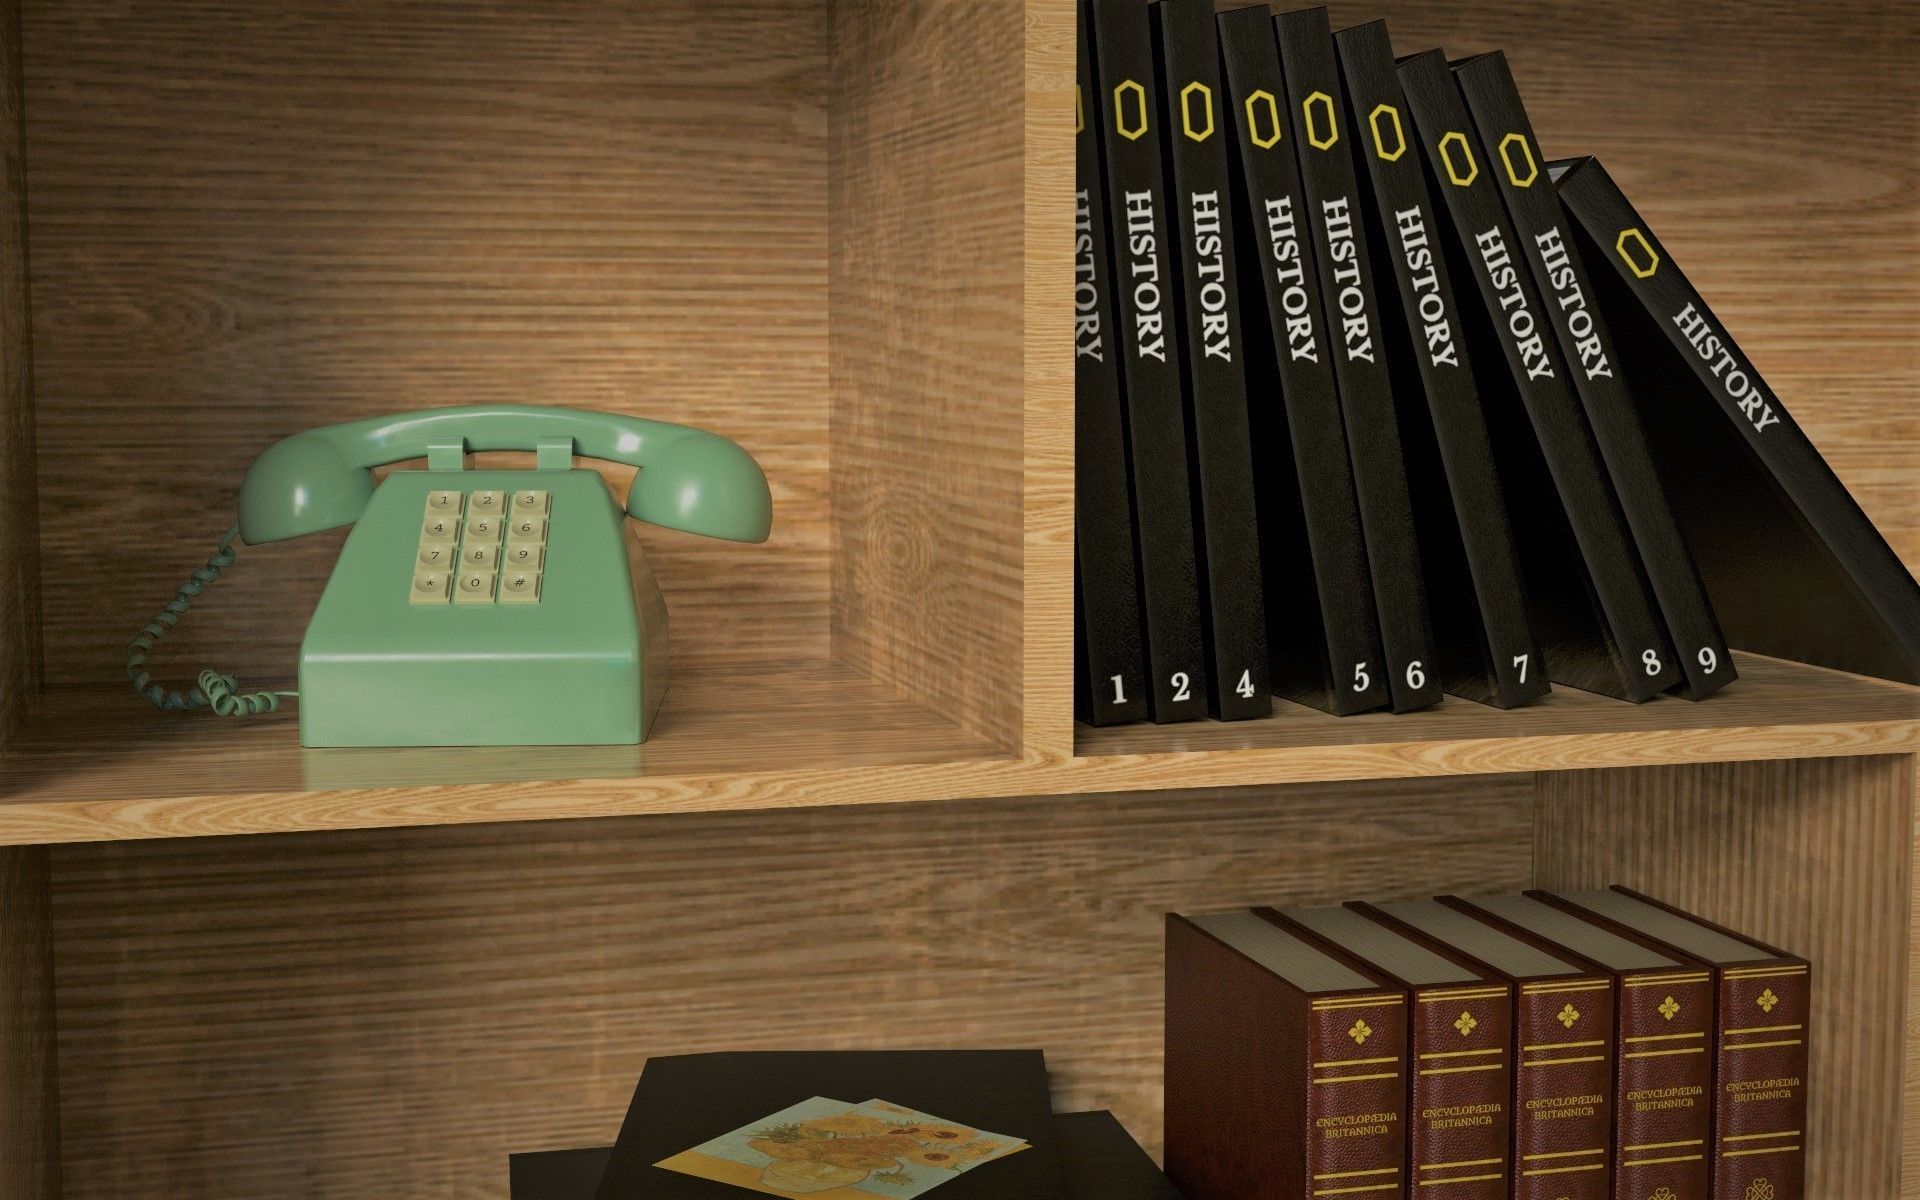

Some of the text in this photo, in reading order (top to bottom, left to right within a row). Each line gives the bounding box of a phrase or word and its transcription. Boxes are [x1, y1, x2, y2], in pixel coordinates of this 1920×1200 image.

[1125, 189, 1165, 363] HISTORY
[1191, 190, 1231, 363] HISTORY
[1265, 195, 1318, 364] HISTORY
[1322, 196, 1375, 364] HISTORY
[1395, 205, 1458, 367] HISTORY
[1475, 225, 1554, 381] HISTORY
[1535, 226, 1613, 381] HISTORY
[1672, 302, 1780, 433] HISTORY
[440, 496, 534, 505] 1 2 3
[434, 523, 531, 532] 4 5 6
[430, 550, 528, 560] 7 8 9
[1406, 660, 1426, 690] 6
[1513, 653, 1530, 684] 7
[1641, 648, 1662, 676] 8
[1697, 646, 1717, 675] 9
[1110, 674, 1128, 704] 1
[1170, 671, 1191, 702] 2
[1235, 669, 1255, 699] 4
[1353, 661, 1370, 693] 5
[1635, 1098, 1694, 1112] BRITANNICA
[1734, 1089, 1791, 1103] BRITANNICA
[1431, 1116, 1492, 1130] BRITANNICA
[1534, 1107, 1594, 1120] BRITANNICA
[1325, 1125, 1388, 1139] BRITANNICA
